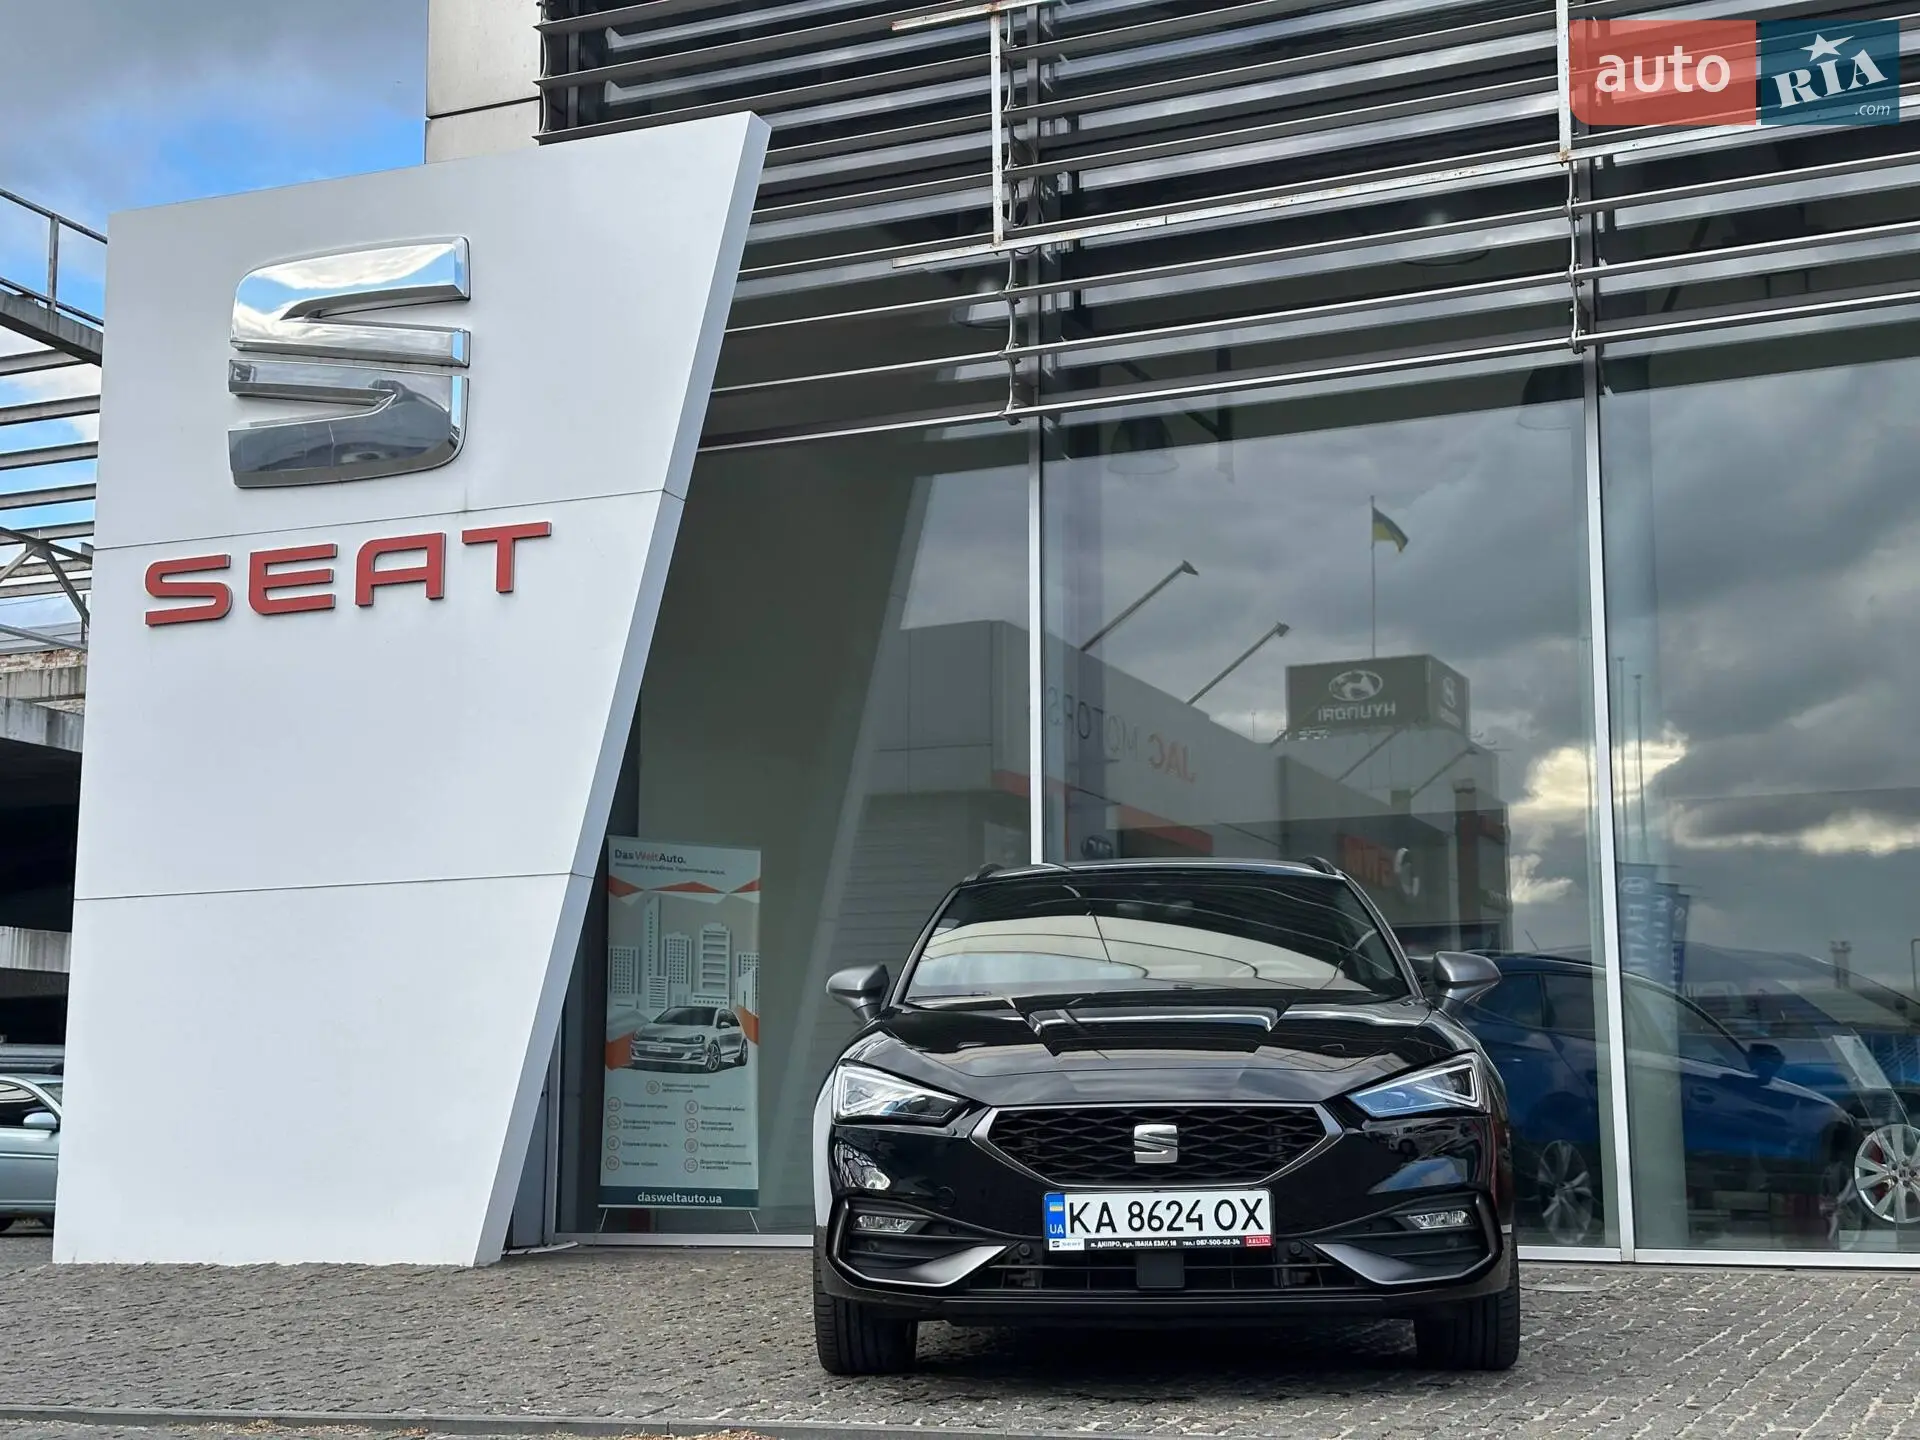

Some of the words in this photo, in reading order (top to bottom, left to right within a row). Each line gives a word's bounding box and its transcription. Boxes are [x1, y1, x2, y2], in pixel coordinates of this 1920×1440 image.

[145, 521, 553, 627] SEAT
[637, 1191, 723, 1204] dasweltauto.ua
[1069, 1201, 1117, 1234] KA
[1127, 1199, 1204, 1232] 8624
[1214, 1198, 1264, 1231] OX
[1049, 1224, 1065, 1235] UA
